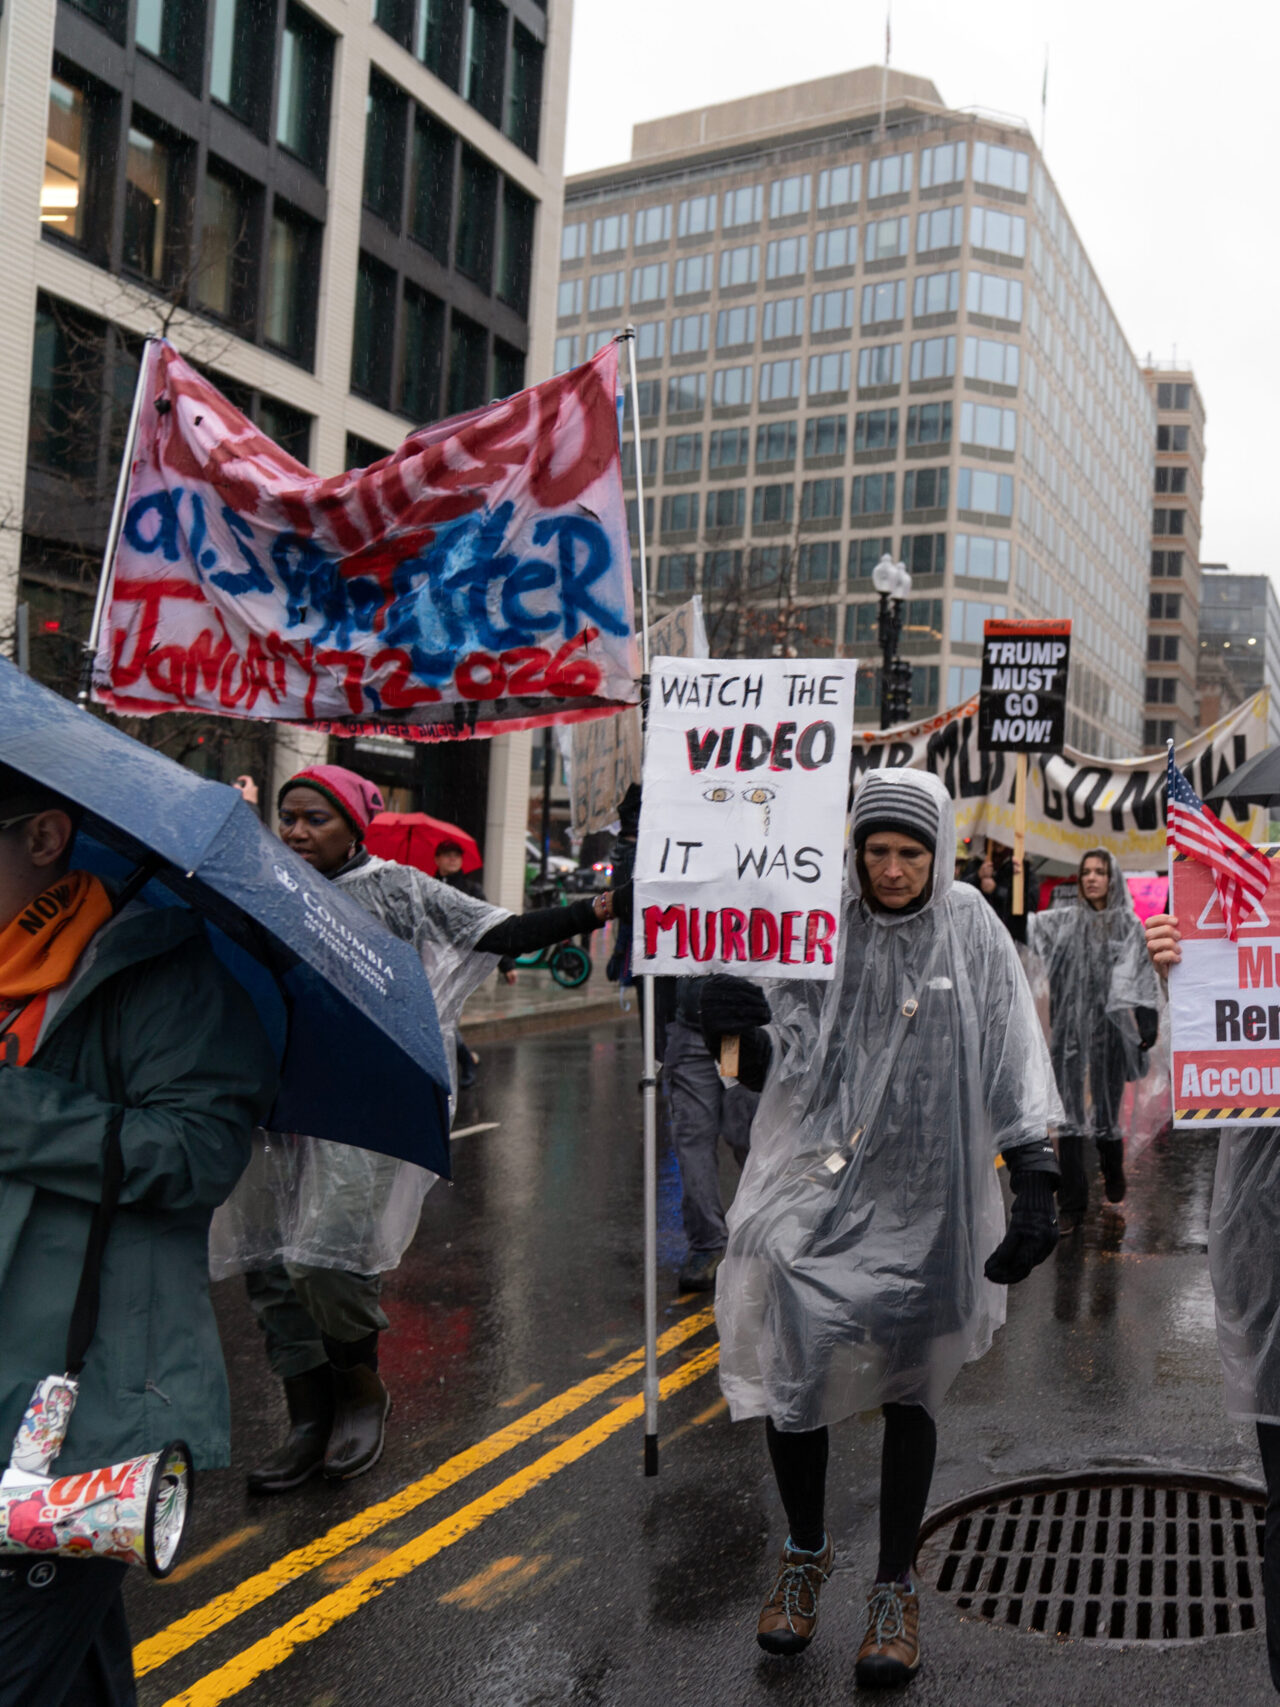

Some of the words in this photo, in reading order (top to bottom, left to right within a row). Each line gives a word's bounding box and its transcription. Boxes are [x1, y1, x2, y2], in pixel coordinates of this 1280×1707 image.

[988, 642, 1066, 665] TRUMP
[661, 673, 763, 709] WATCH
[784, 674, 844, 706] THE
[992, 668, 1057, 691] MUST
[1005, 693, 1038, 717] GO
[685, 720, 836, 774] VIDEO
[991, 719, 1053, 743] NOW!
[659, 837, 703, 874] IT
[735, 843, 823, 883] WAS
[302, 892, 394, 980] COLUMBIA
[642, 904, 837, 964] MURDER
